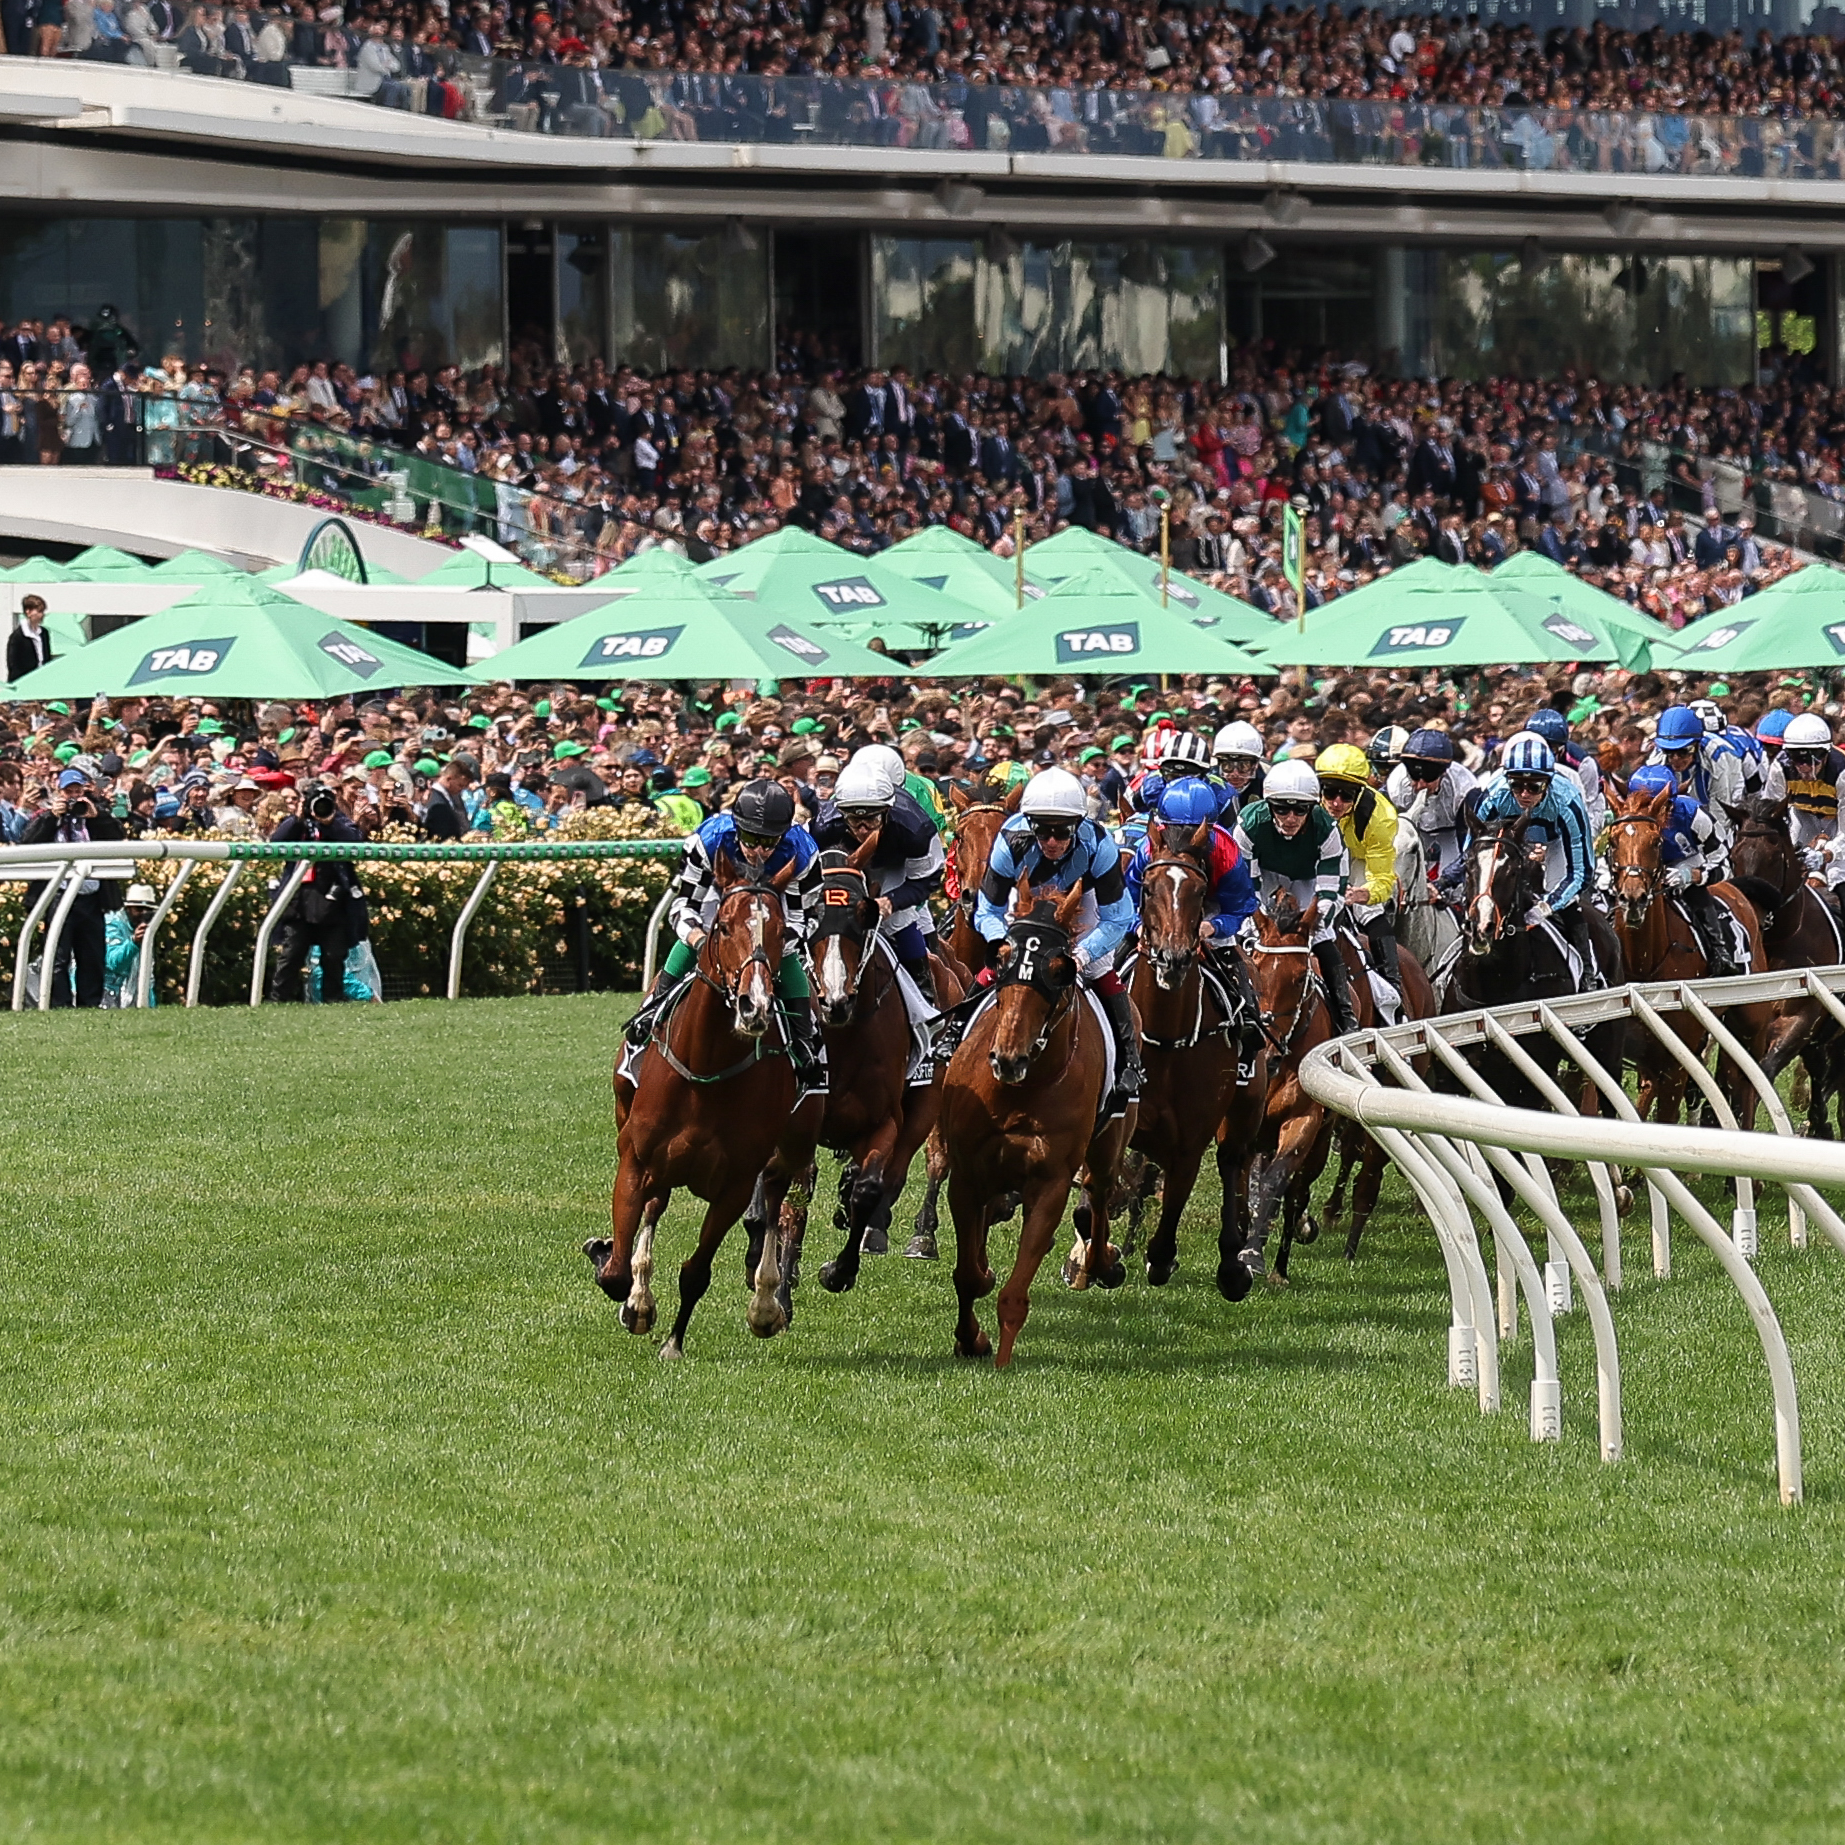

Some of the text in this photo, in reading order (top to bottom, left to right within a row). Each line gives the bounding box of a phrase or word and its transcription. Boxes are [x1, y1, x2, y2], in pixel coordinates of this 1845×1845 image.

[817, 585, 881, 604] TAB
[602, 636, 668, 656] TAB
[1063, 633, 1134, 652] TAB
[1389, 627, 1451, 646] TAB
[150, 648, 218, 672] TAB
[1018, 936, 1041, 982] CLM
